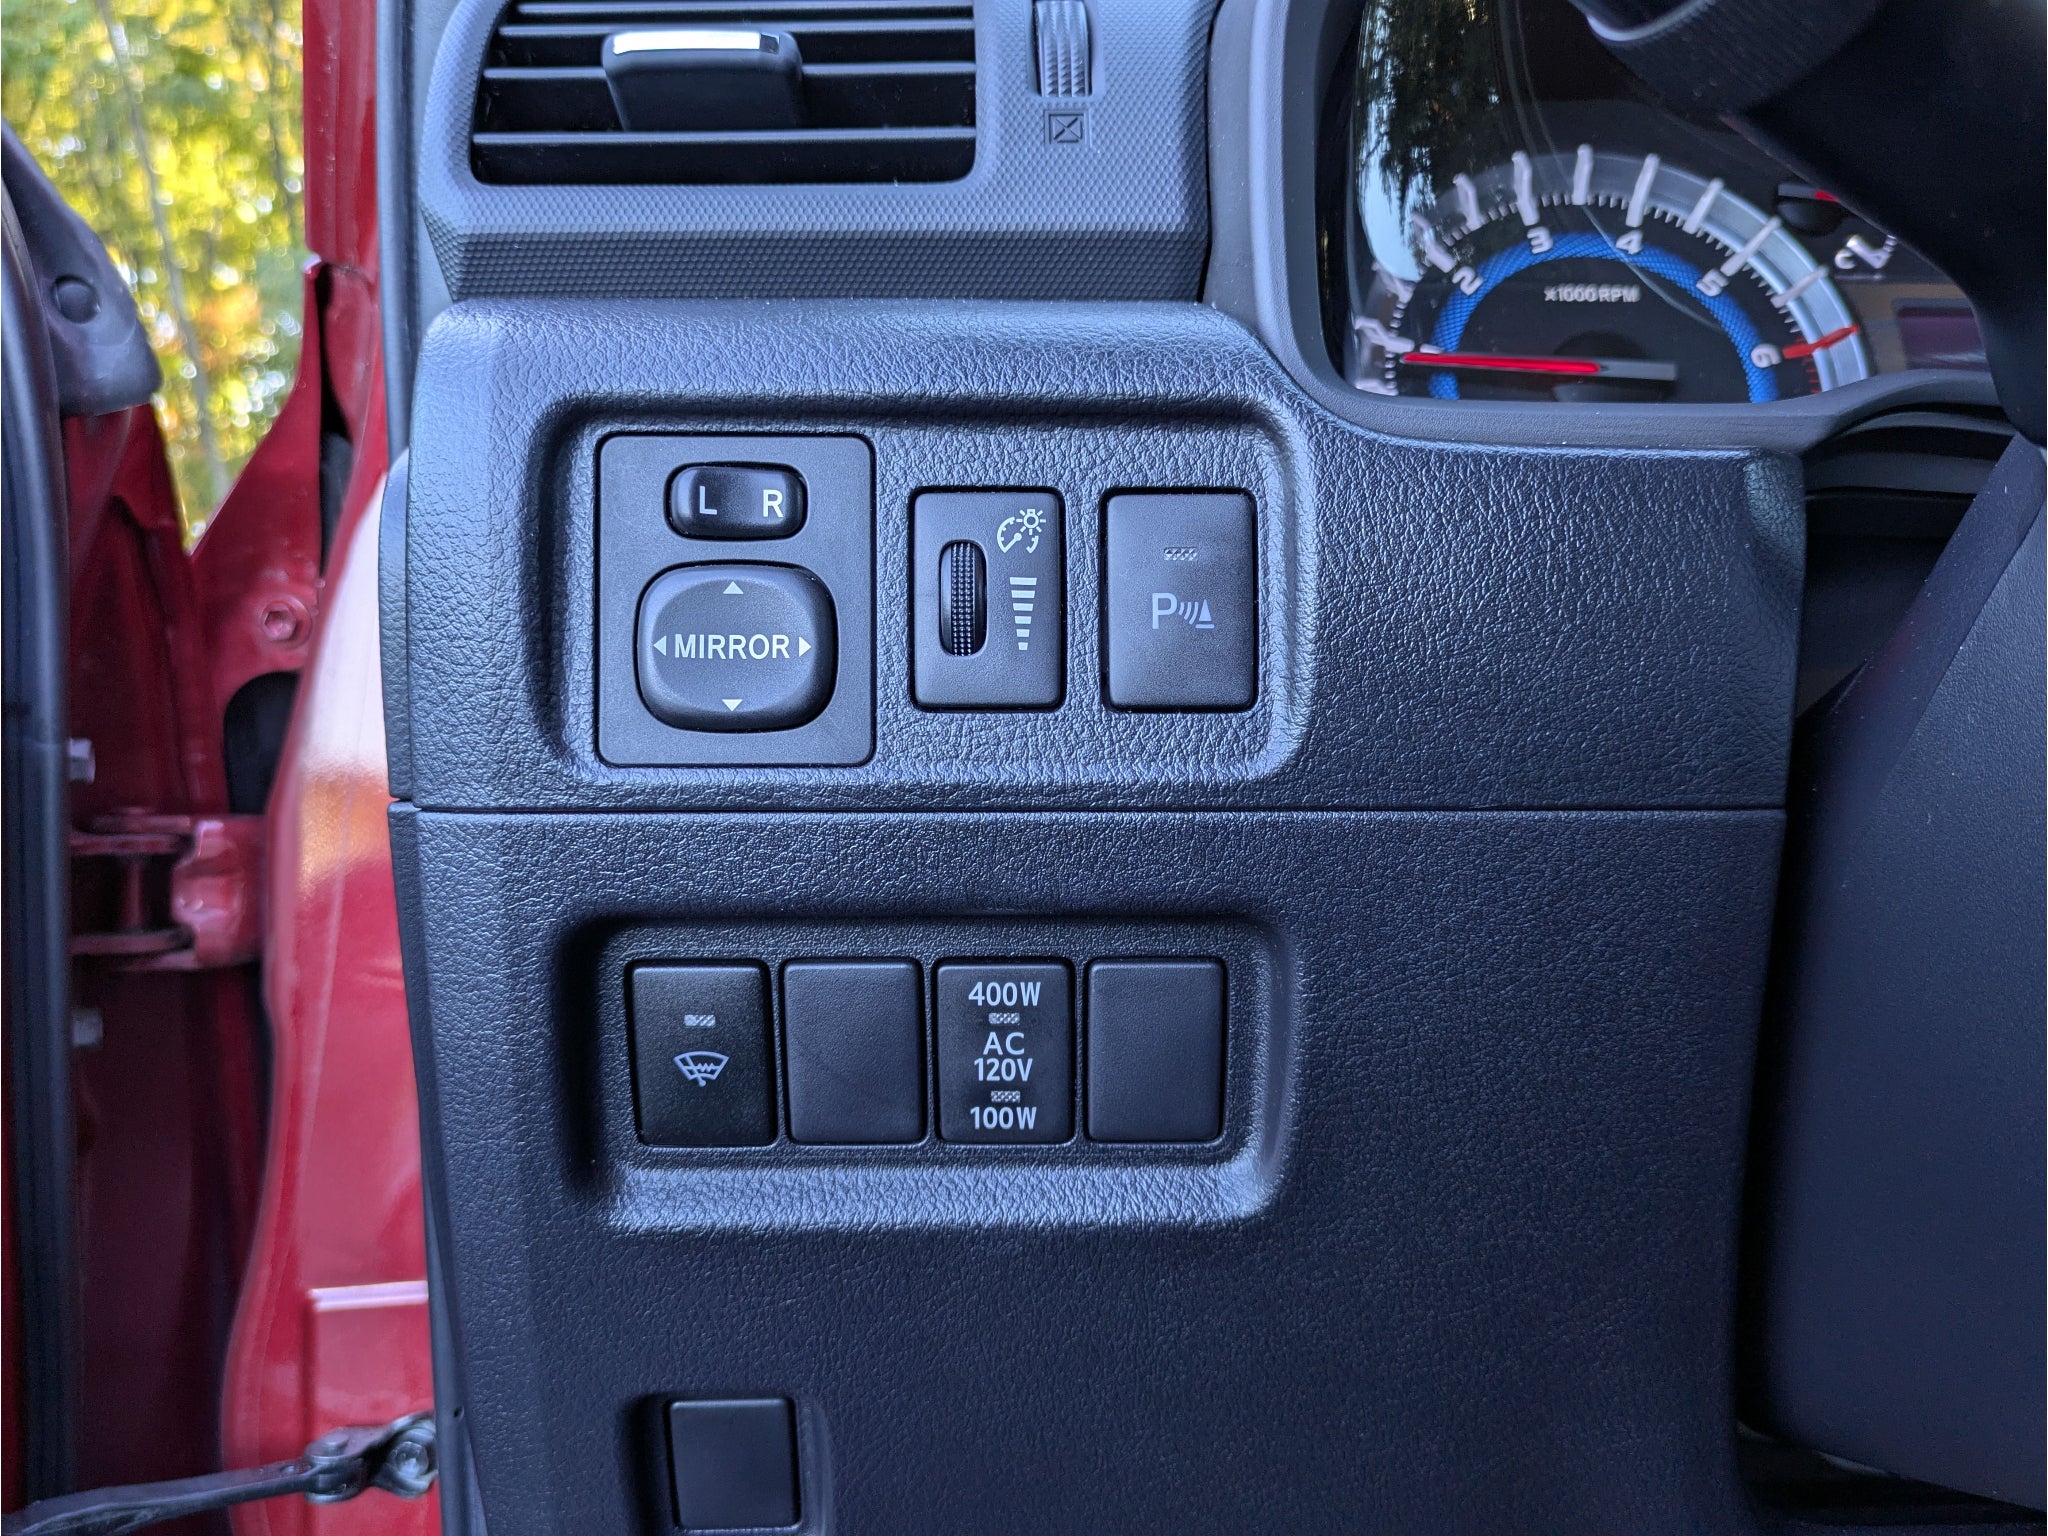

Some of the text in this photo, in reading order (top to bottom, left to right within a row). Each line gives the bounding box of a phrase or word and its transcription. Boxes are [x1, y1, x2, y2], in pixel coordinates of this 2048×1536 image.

[1527, 226, 1553, 254] 3
[1616, 230, 1643, 255] 4
[1452, 266, 1484, 296] 2
[1598, 284, 1640, 302] RPM
[1696, 268, 1730, 297] 5
[1751, 343, 1781, 368] 6
[699, 485, 784, 518] L R
[1152, 592, 1178, 630] P
[674, 633, 790, 660] MIRROR
[968, 981, 1041, 1007] 400W
[982, 1031, 1025, 1055] AC
[973, 1058, 1033, 1082] 120V
[969, 1106, 1037, 1130] 100W
